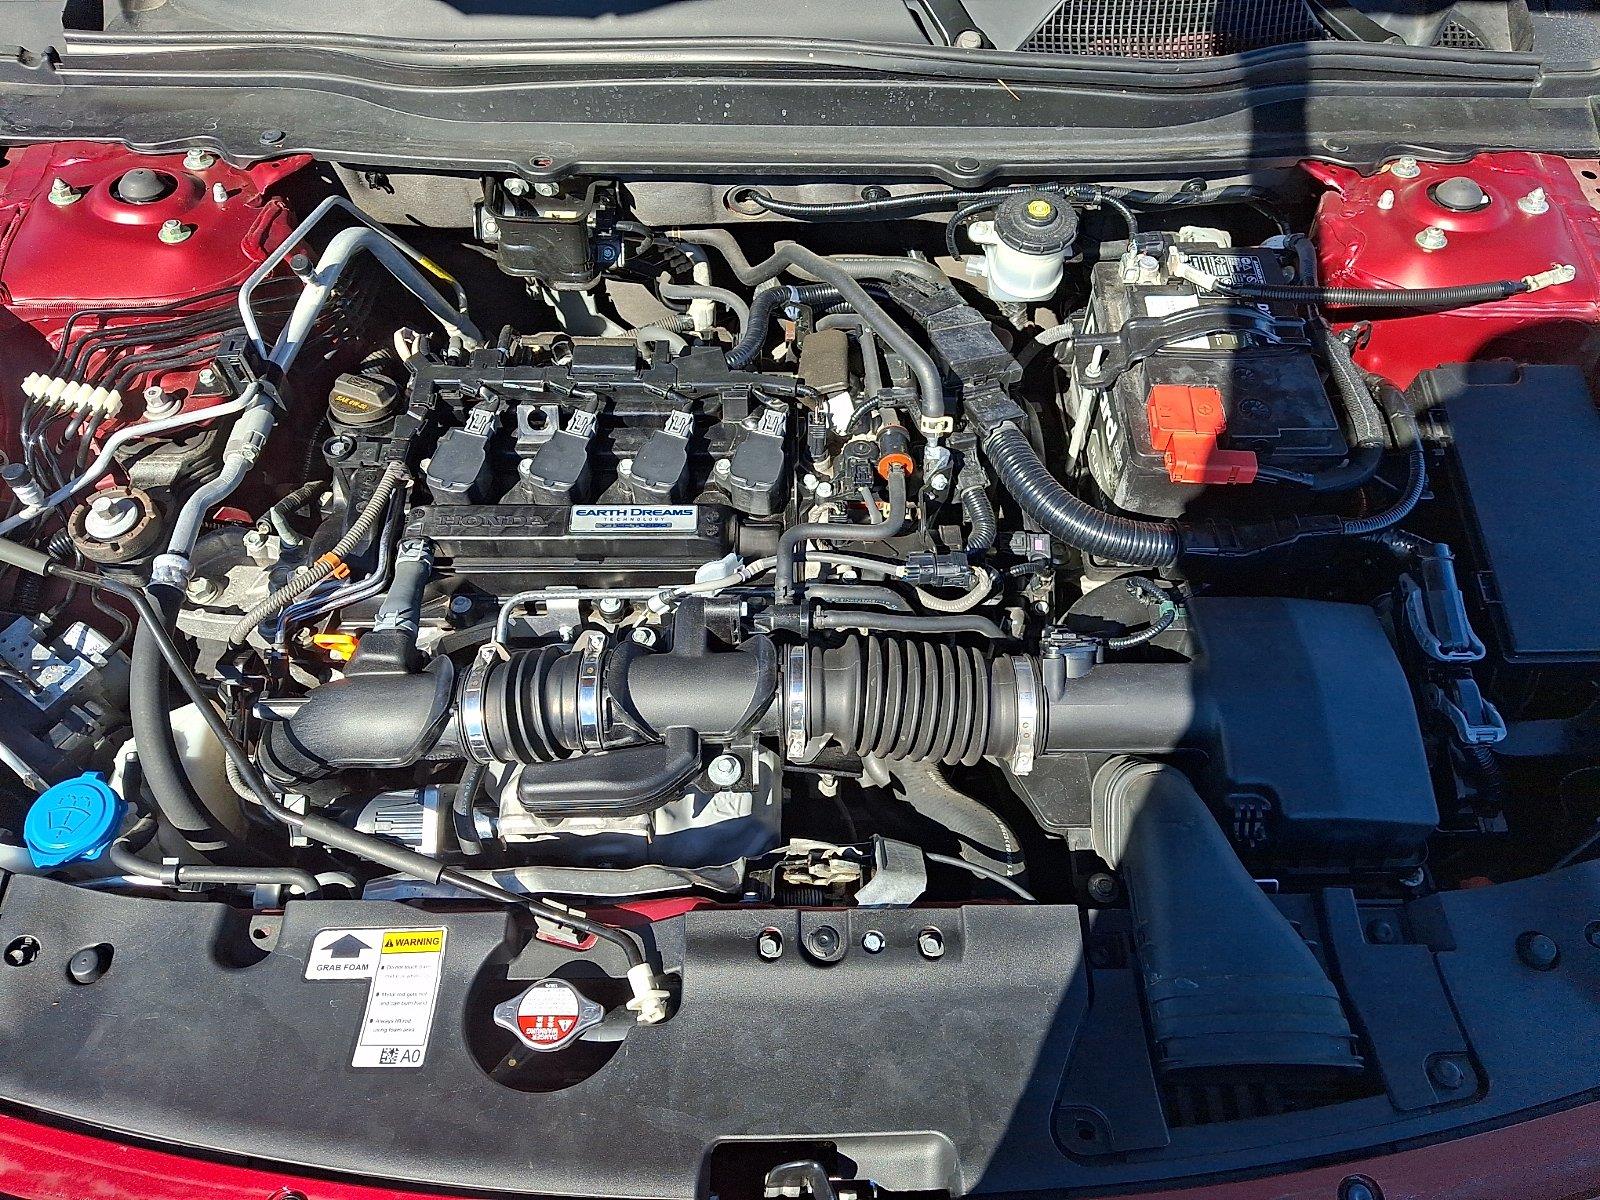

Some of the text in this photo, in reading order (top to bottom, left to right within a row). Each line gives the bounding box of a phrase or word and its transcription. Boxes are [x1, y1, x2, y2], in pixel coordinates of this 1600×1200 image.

[630, 508, 693, 516] DREAMS
[437, 515, 549, 527] HONDA
[395, 937, 440, 947] WARNING
[343, 963, 369, 971] FOAM
[399, 1049, 421, 1063] A0
